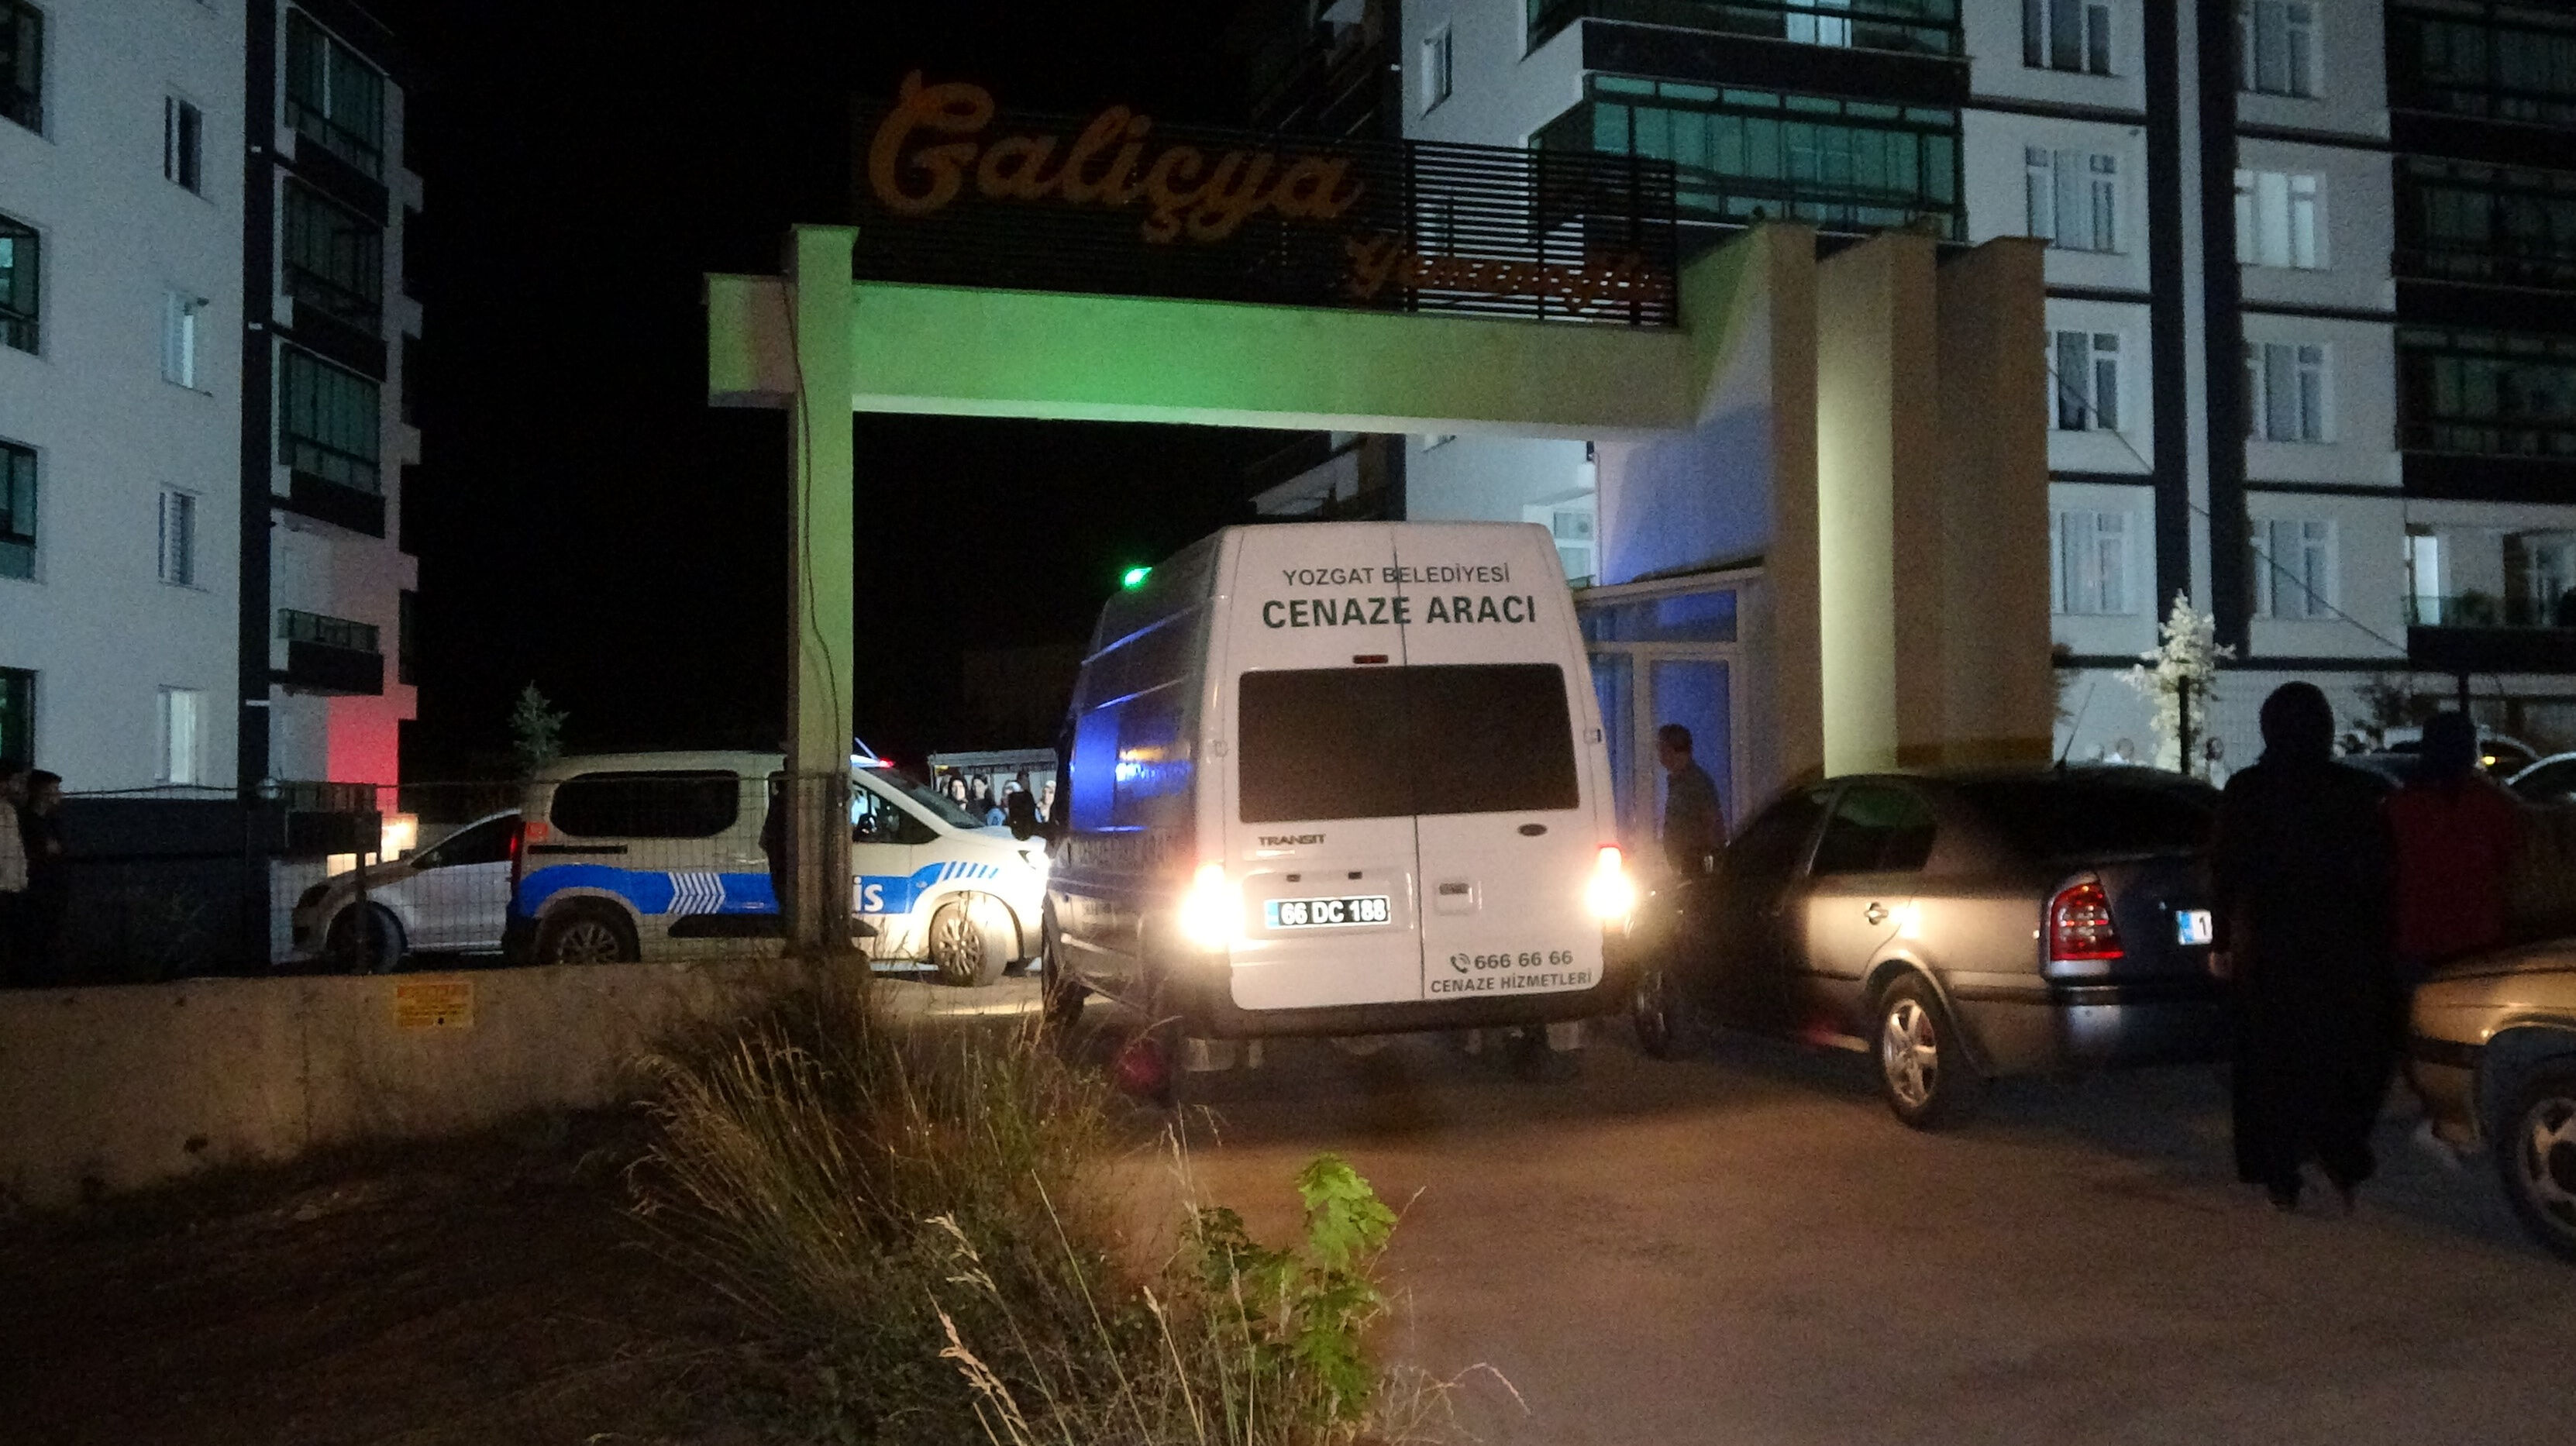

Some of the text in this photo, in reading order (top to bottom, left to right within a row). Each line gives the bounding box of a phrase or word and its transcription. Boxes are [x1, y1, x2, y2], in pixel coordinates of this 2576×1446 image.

[1283, 562, 1510, 586] YOZGAT BELEDİYESİ
[1262, 594, 1536, 628] CENAZE ARACI
[1258, 833, 1326, 845] TRANSIT
[1280, 899, 1387, 925] 66 DC 188
[1474, 950, 1574, 970] 666 66 66
[1431, 968, 1593, 993] CENAZE HİZMETLERİ
